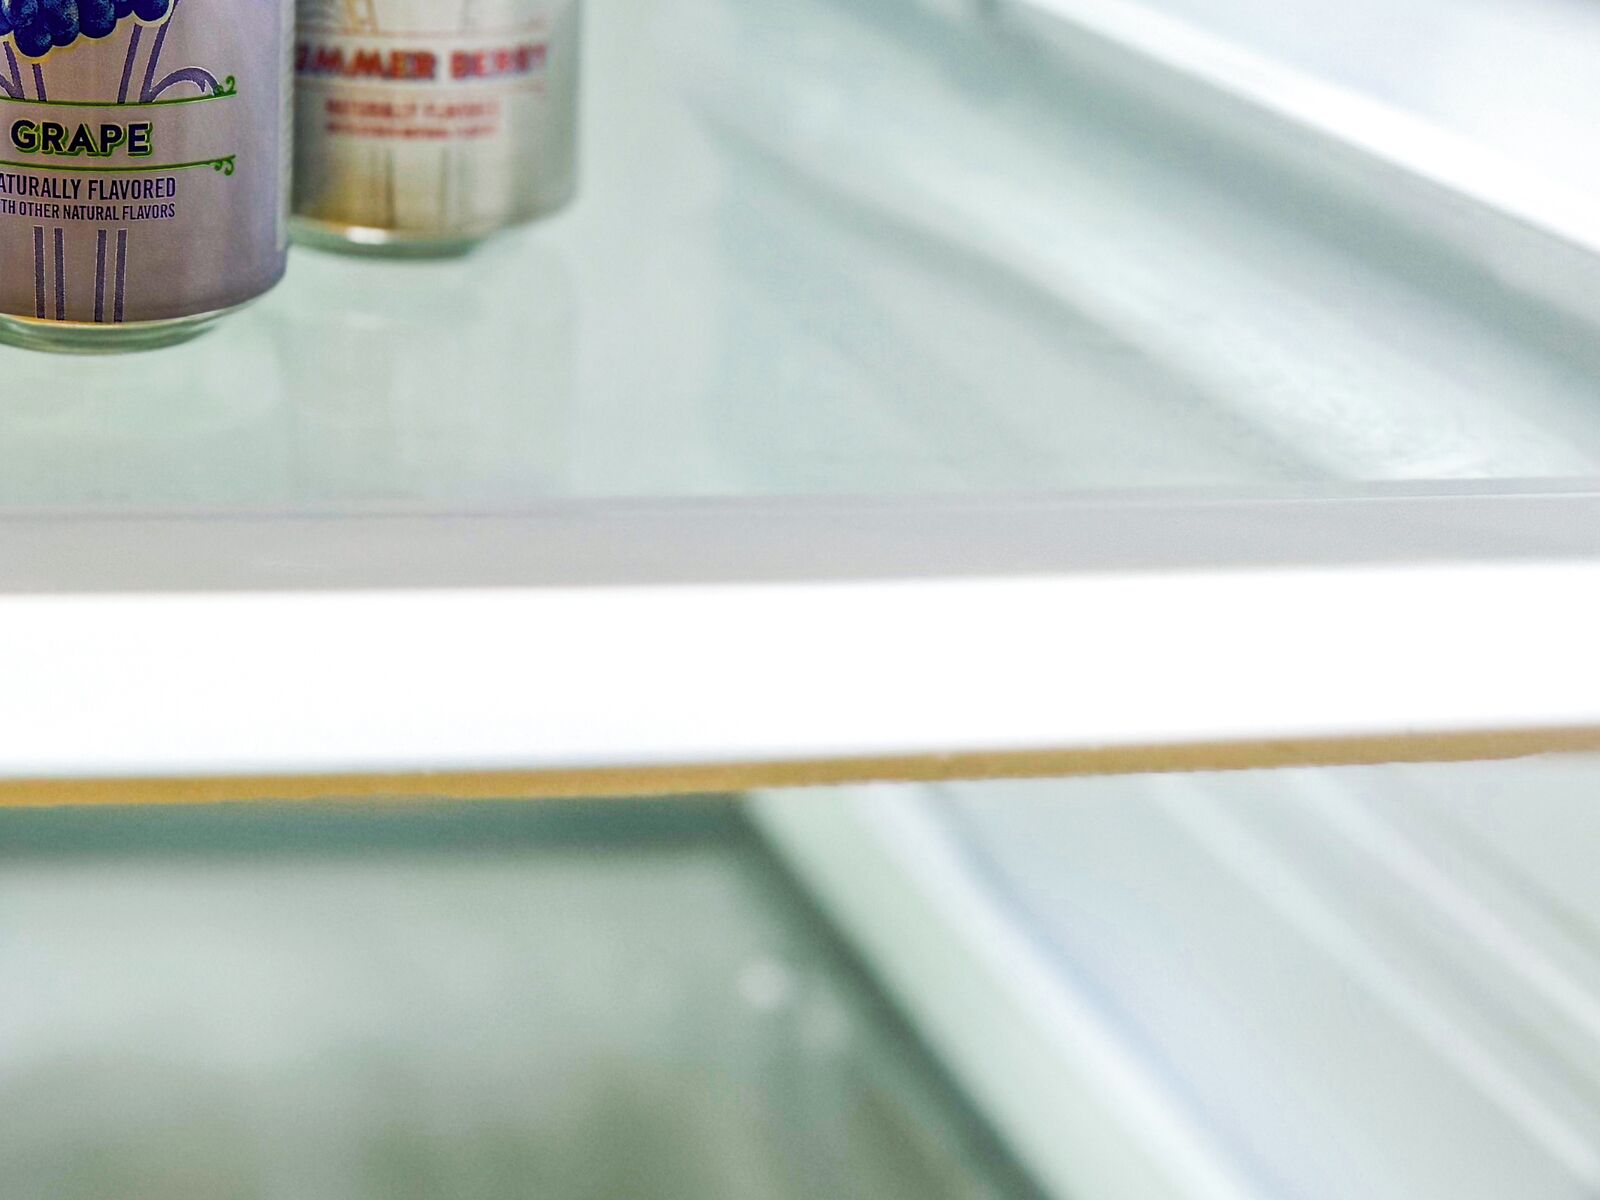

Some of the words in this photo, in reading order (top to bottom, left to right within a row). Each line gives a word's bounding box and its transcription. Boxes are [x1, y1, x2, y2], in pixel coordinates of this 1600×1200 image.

[10, 119, 153, 157] GRAPE
[88, 177, 176, 201] FLAVORED
[19, 202, 60, 219] OTHER
[64, 205, 119, 221] NATURAL
[122, 203, 176, 221] FLAVORS
